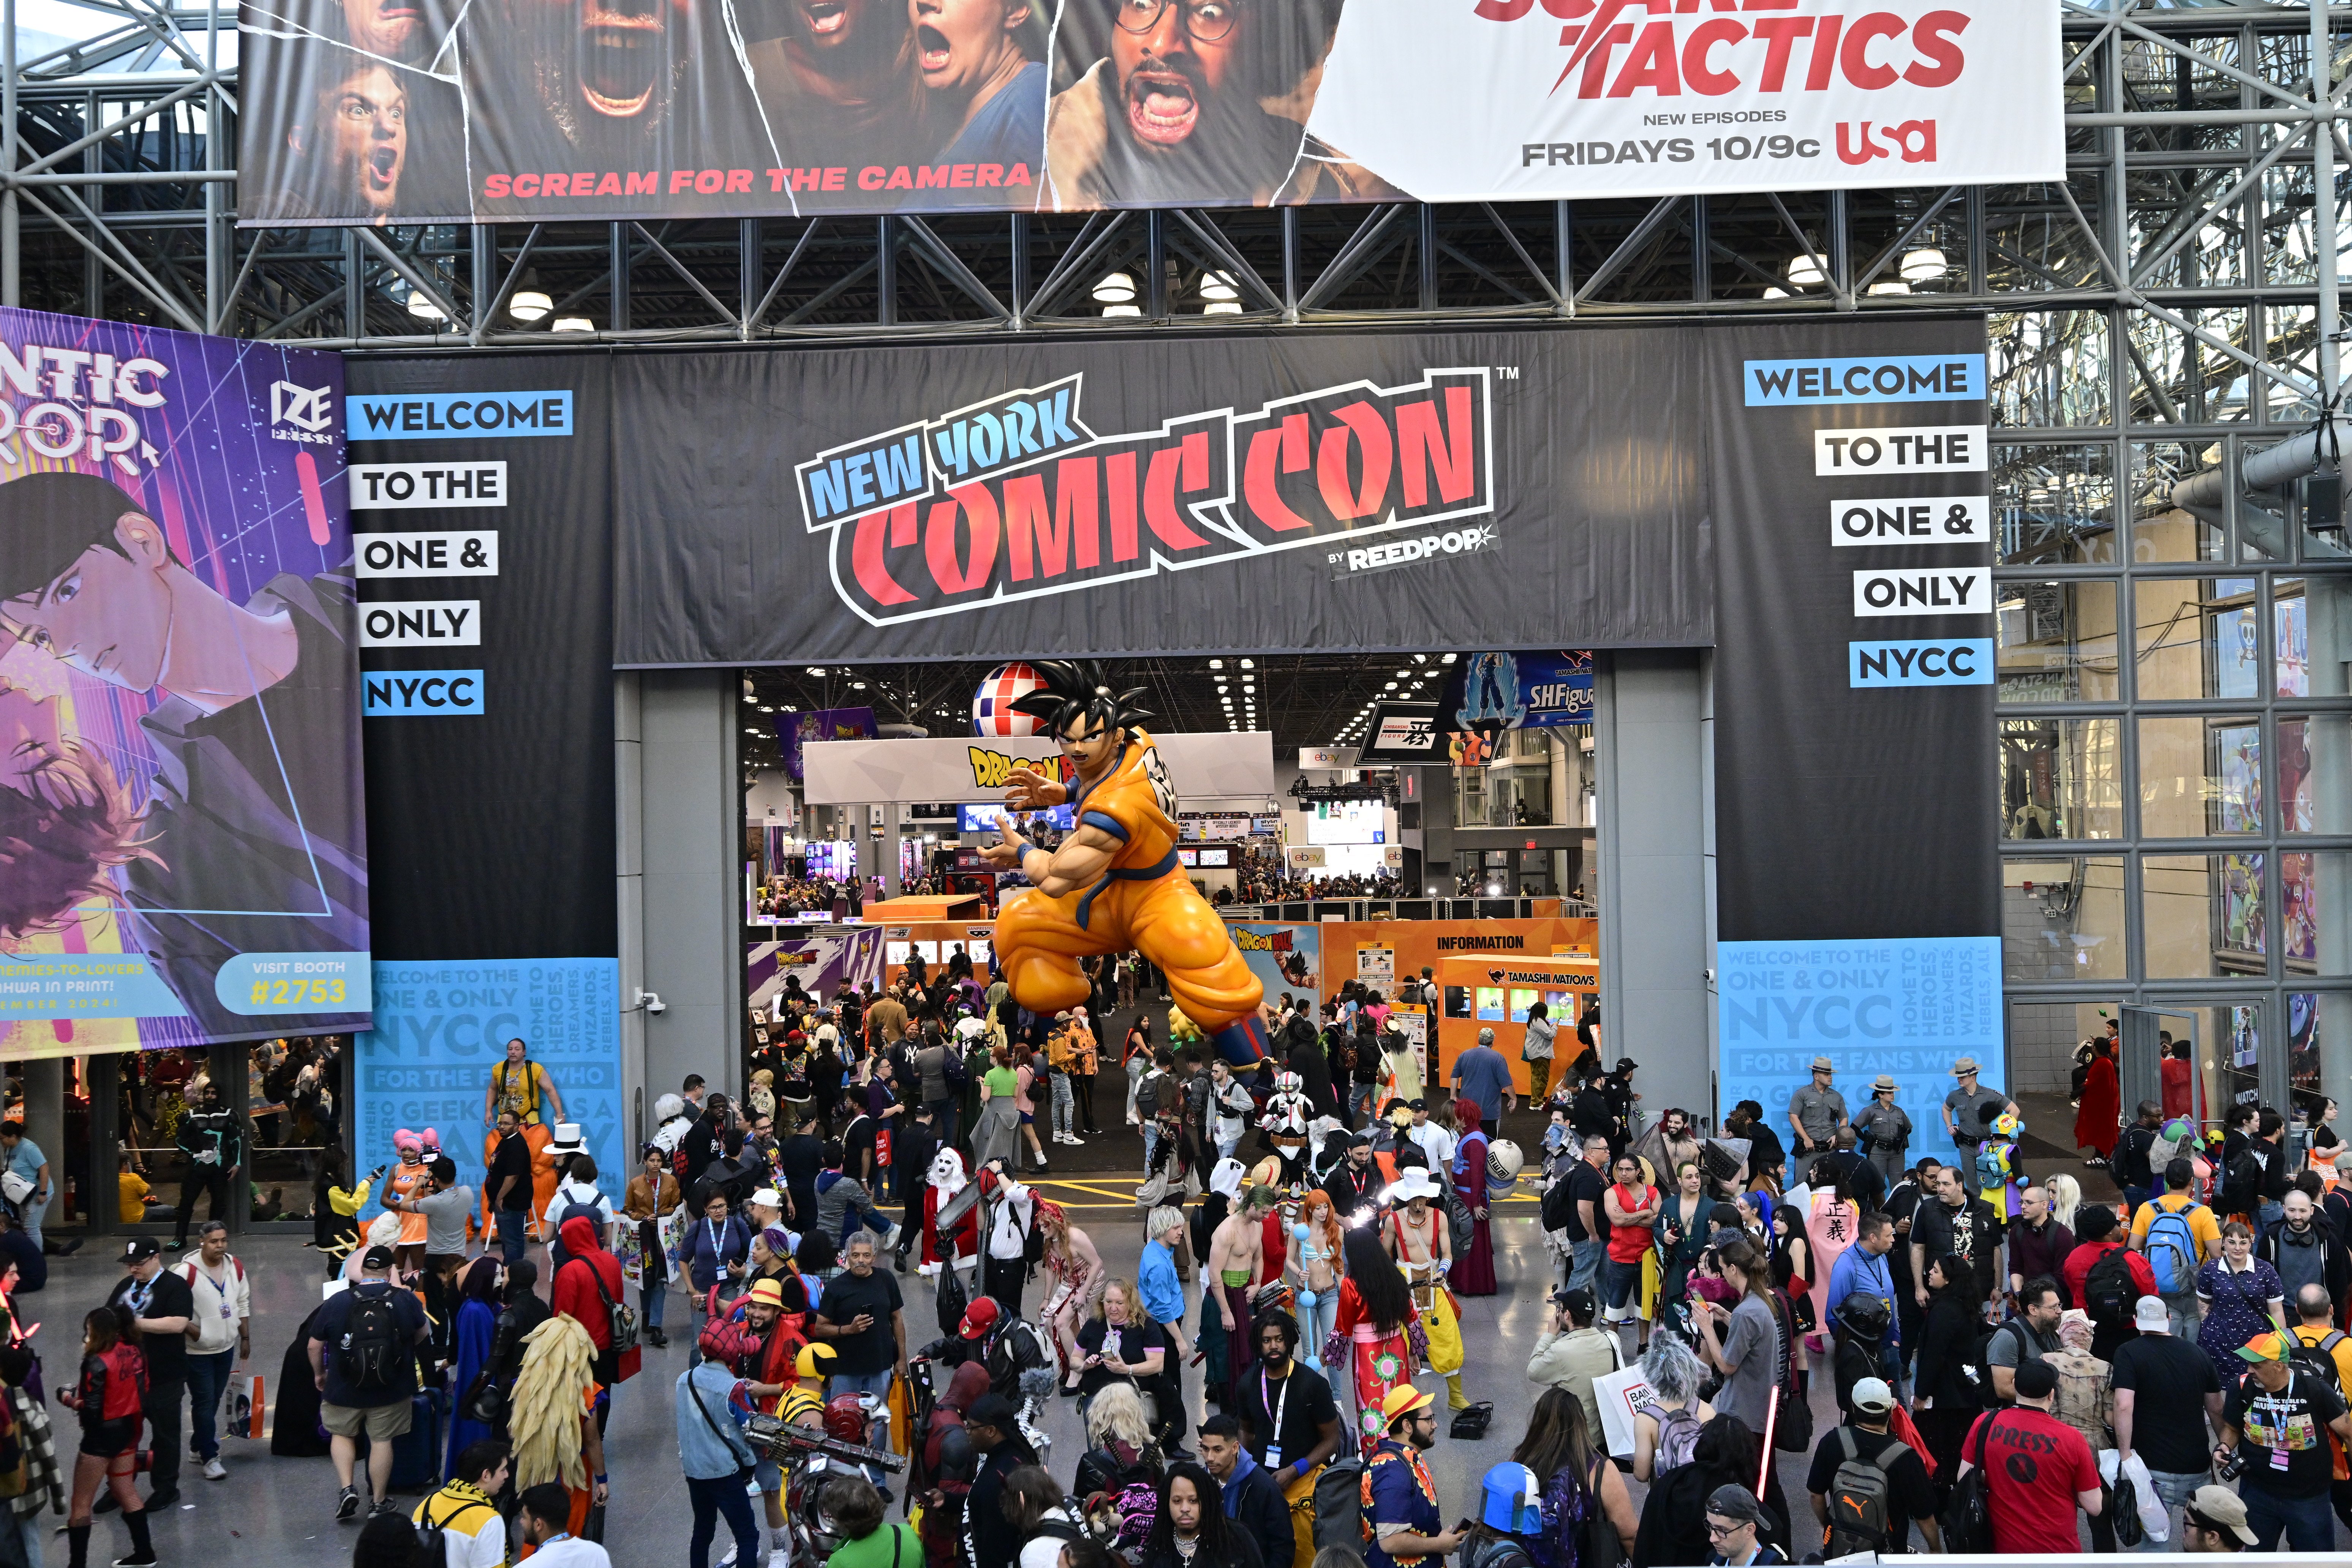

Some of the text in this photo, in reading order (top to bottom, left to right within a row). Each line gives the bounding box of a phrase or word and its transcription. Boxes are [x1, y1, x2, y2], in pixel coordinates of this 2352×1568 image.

[1547, 9, 1971, 100] TACTICS
[1643, 110, 1787, 126] NEW EPISODES
[1522, 135, 1821, 168] FRIDAYS 10/9c
[484, 163, 1032, 197] SCREAM FOR THE CAMERA
[1754, 362, 1967, 399] WELCOME
[362, 398, 563, 432] WELCOME
[272, 429, 333, 445] PRESS
[808, 388, 1080, 518] NEW YORK
[1824, 433, 1969, 467] TO THE
[362, 469, 498, 501] TO THE
[852, 431, 1211, 607] COMIC
[1243, 386, 1474, 532] CON
[1841, 504, 1974, 537] ONE &
[364, 538, 488, 570] ONE &
[1328, 530, 1482, 572] BY REEDPOP
[1864, 575, 1976, 608] ONLY
[365, 608, 469, 639] ONLY
[1555, 668, 1580, 677] TAMASHII
[1860, 646, 1976, 679] NYCC
[368, 677, 474, 708] NYCC
[1315, 752, 1339, 763] ebay
[1295, 852, 1321, 863] ebay
[1235, 926, 1293, 952] DRAGON BALL
[1437, 936, 1524, 950] INFORMATION
[253, 961, 346, 974] VISIT BOOTH
[775, 951, 803, 964] DRAGON
[1727, 949, 1890, 965] WELCOME TO THE
[0, 981, 40, 994] HWA
[250, 978, 347, 1005] #2753
[455, 970, 480, 983] TO
[483, 969, 518, 982] THE
[1508, 972, 1551, 984] TAMASHII
[1727, 968, 1890, 991] ONE & ONLY
[1902, 947, 1917, 1037] HOME TO
[1920, 947, 1939, 1037] HEROES,
[1942, 946, 1955, 1036] DREAMERS,
[1958, 946, 1975, 1036] WIZARDS,
[1978, 946, 1992, 1035] REBELS, ALL
[69, 999, 119, 1008] 2024!
[423, 989, 441, 1008] &
[447, 988, 518, 1008] ONLY
[529, 967, 545, 1054] HOME TO
[548, 967, 565, 1053] HEROES,
[568, 967, 580, 1053] DREAMERS,
[584, 967, 598, 1053] WIZARDS,
[601, 967, 612, 1053] REBELS, ALL
[1728, 994, 1892, 1041] NYCC
[365, 1013, 520, 1057] NYCC
[1740, 1054, 1790, 1072] FOR
[1849, 1051, 1915, 1070] FANS
[375, 1070, 421, 1088] FOR
[425, 1069, 472, 1086] THE
[401, 1100, 480, 1122] GEEK
[2235, 1088, 2259, 1105] WATCH
[1825, 1203, 1847, 1243] 正義
[1990, 1425, 2058, 1454] PRESS
